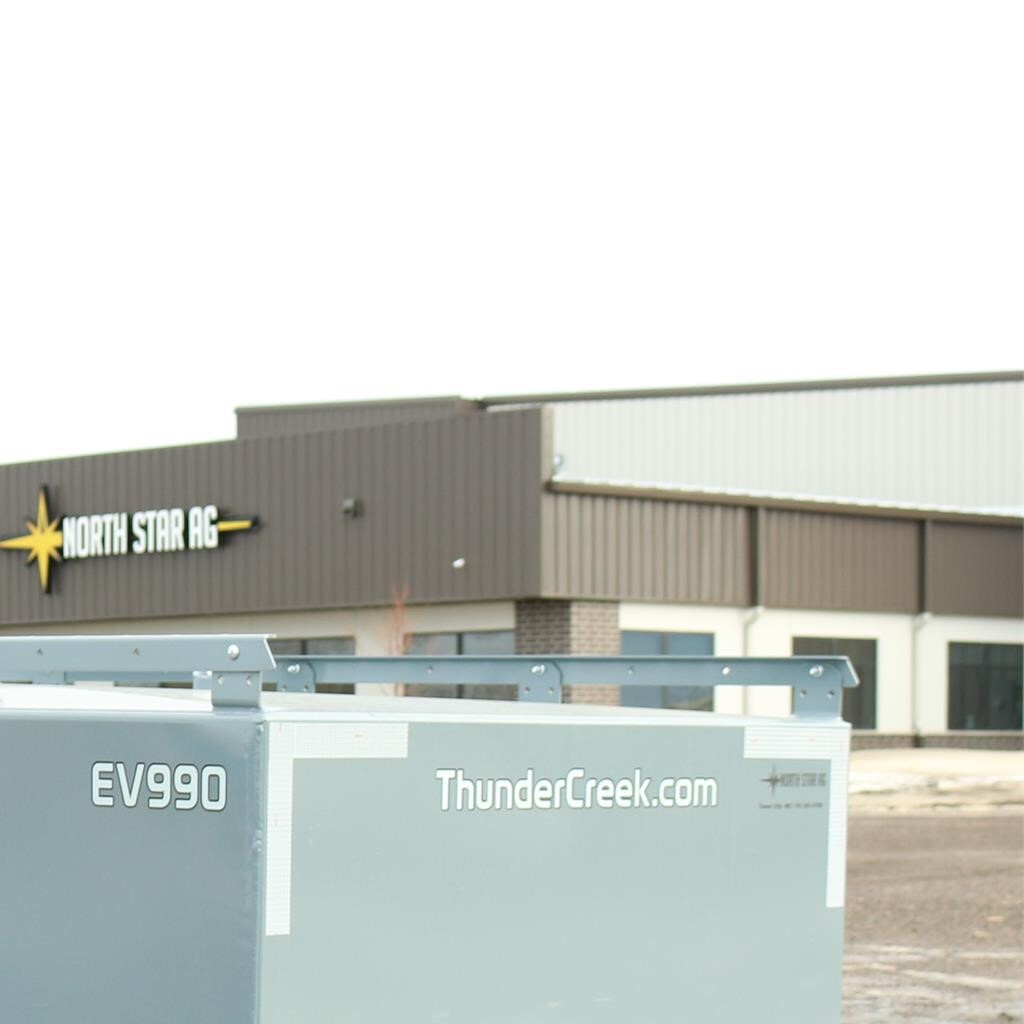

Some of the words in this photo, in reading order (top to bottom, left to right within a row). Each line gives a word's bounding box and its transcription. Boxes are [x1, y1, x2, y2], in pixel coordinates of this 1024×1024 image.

[62, 512, 128, 559] NORTH
[132, 508, 185, 553] STAR
[188, 505, 218, 550] AG
[91, 760, 227, 812] EV990
[435, 768, 719, 811] ThunderCreek.com
